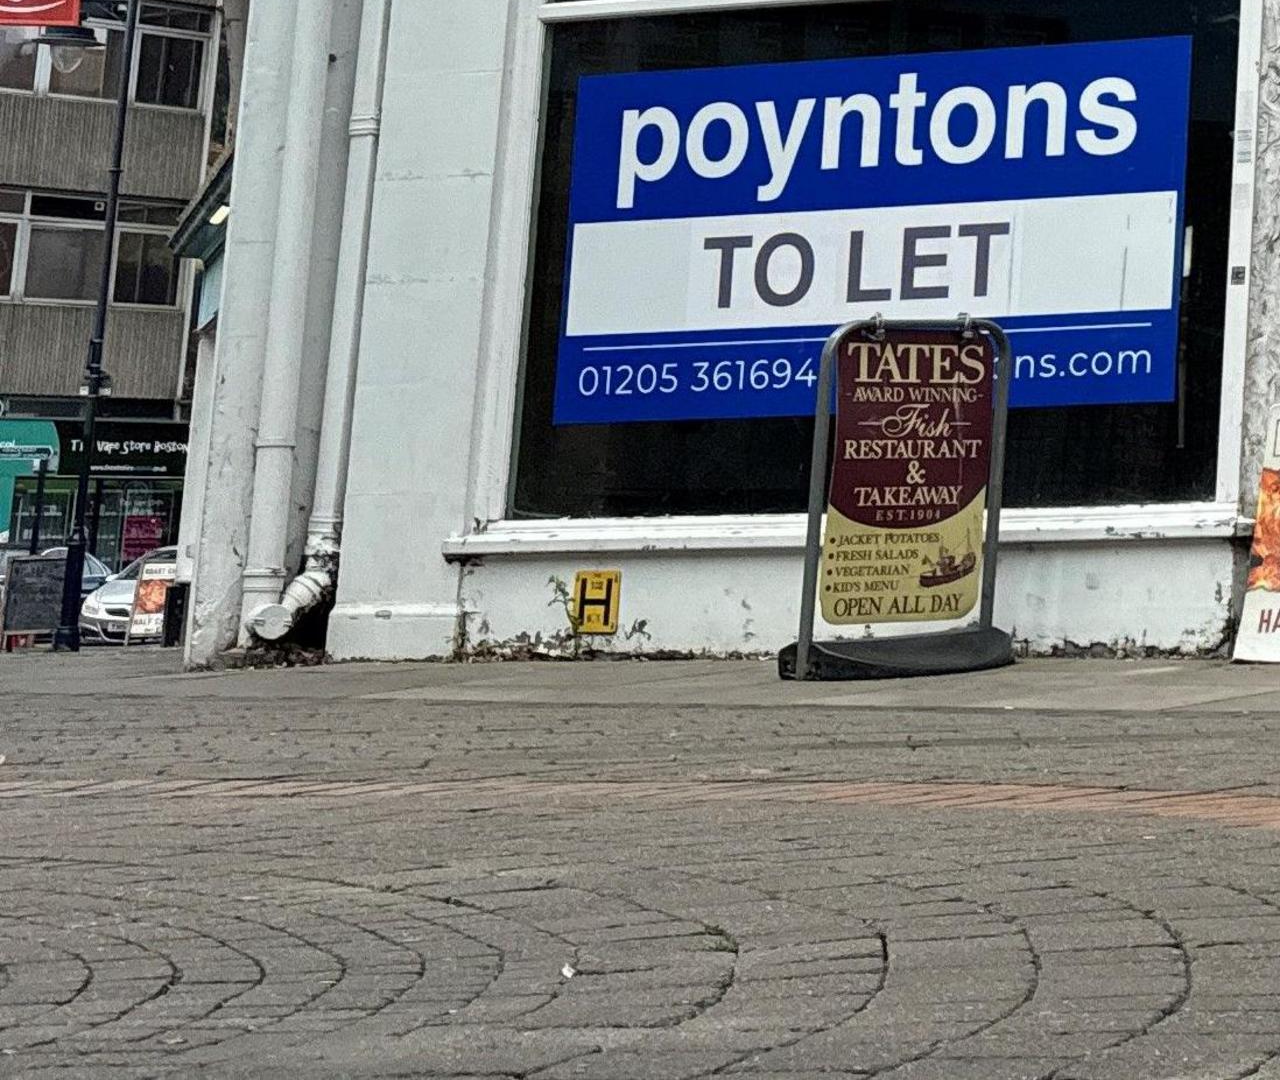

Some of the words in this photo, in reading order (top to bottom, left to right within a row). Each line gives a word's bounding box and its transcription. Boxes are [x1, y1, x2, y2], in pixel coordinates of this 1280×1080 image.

[616, 72, 1138, 209] poyntons
[704, 232, 815, 308] TO
[846, 222, 1010, 303] LET
[579, 363, 678, 396] 01205
[690, 358, 818, 392] 361694
[1014, 350, 1151, 379] ns.com
[847, 341, 985, 385] TATES
[853, 386, 904, 402] AWARD
[908, 387, 977, 402] WINNING
[881, 404, 953, 438] Fish
[844, 439, 982, 459] RESTAURANT
[906, 460, 926, 485] &
[854, 485, 963, 507] TAKEAWAY
[837, 534, 881, 547] JACKET
[884, 532, 940, 545] POTATOES
[836, 550, 872, 561] FRESH
[875, 549, 919, 560] SALADS
[835, 564, 911, 577] VEGETARIAN
[864, 580, 899, 592] MENU
[578, 578, 613, 626] H
[833, 596, 884, 617] OPEN
[887, 595, 925, 615] ALL
[929, 593, 963, 612] DAY
